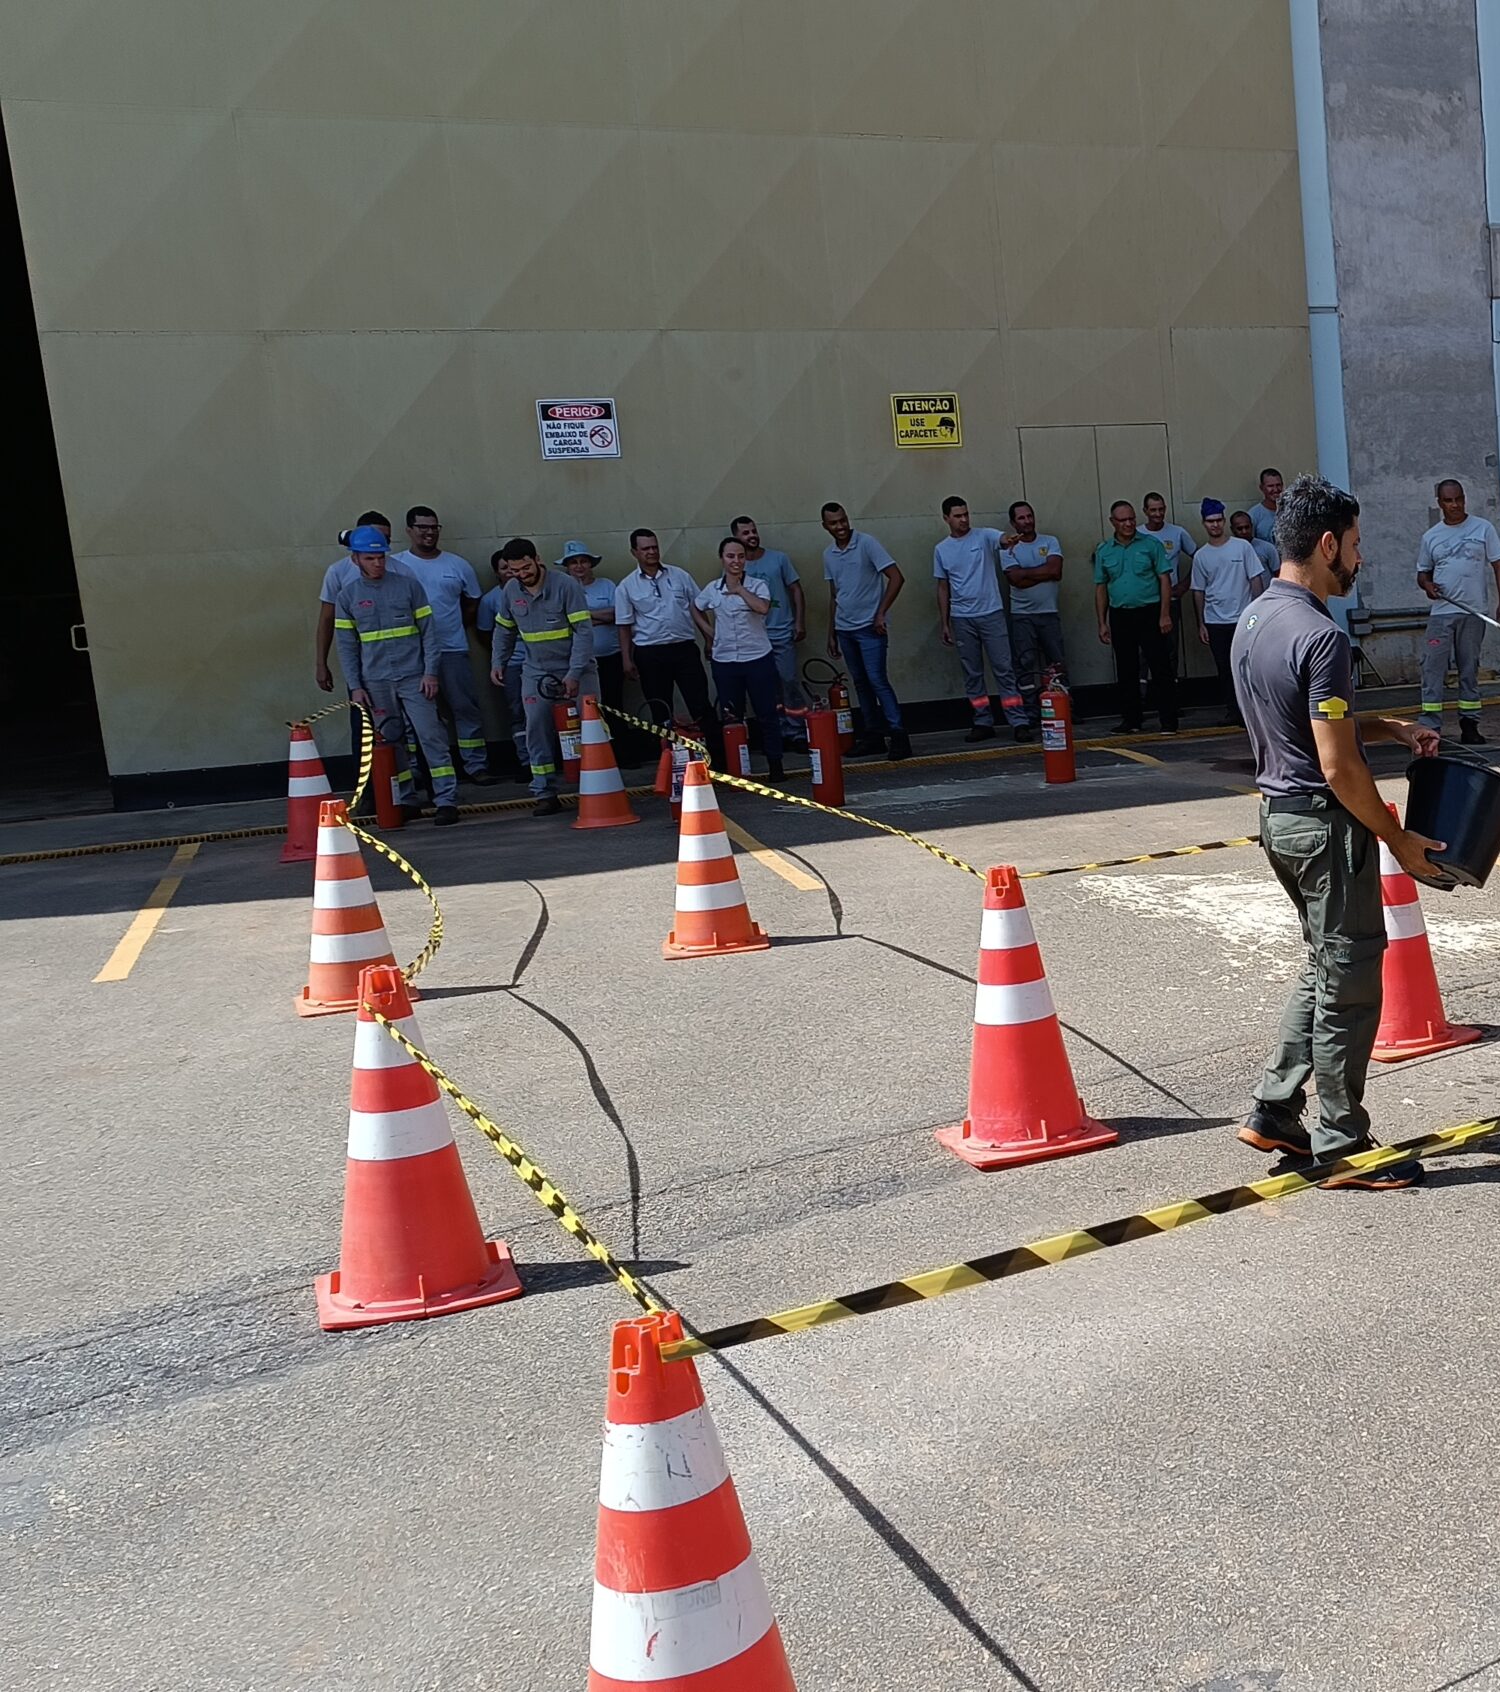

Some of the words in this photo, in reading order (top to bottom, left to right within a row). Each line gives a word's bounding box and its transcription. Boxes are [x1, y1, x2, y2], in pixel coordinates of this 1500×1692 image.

[901, 398, 950, 413] ATENÇÃO
[555, 407, 599, 417] PERIGO
[546, 422, 562, 430] NÃO
[563, 422, 585, 430] FIQUE
[910, 418, 926, 427] USE
[545, 431, 577, 439] EMBAIXO
[578, 430, 588, 438] DE
[899, 429, 938, 439] CAPACETE
[547, 446, 590, 454] SUSPENSAS
